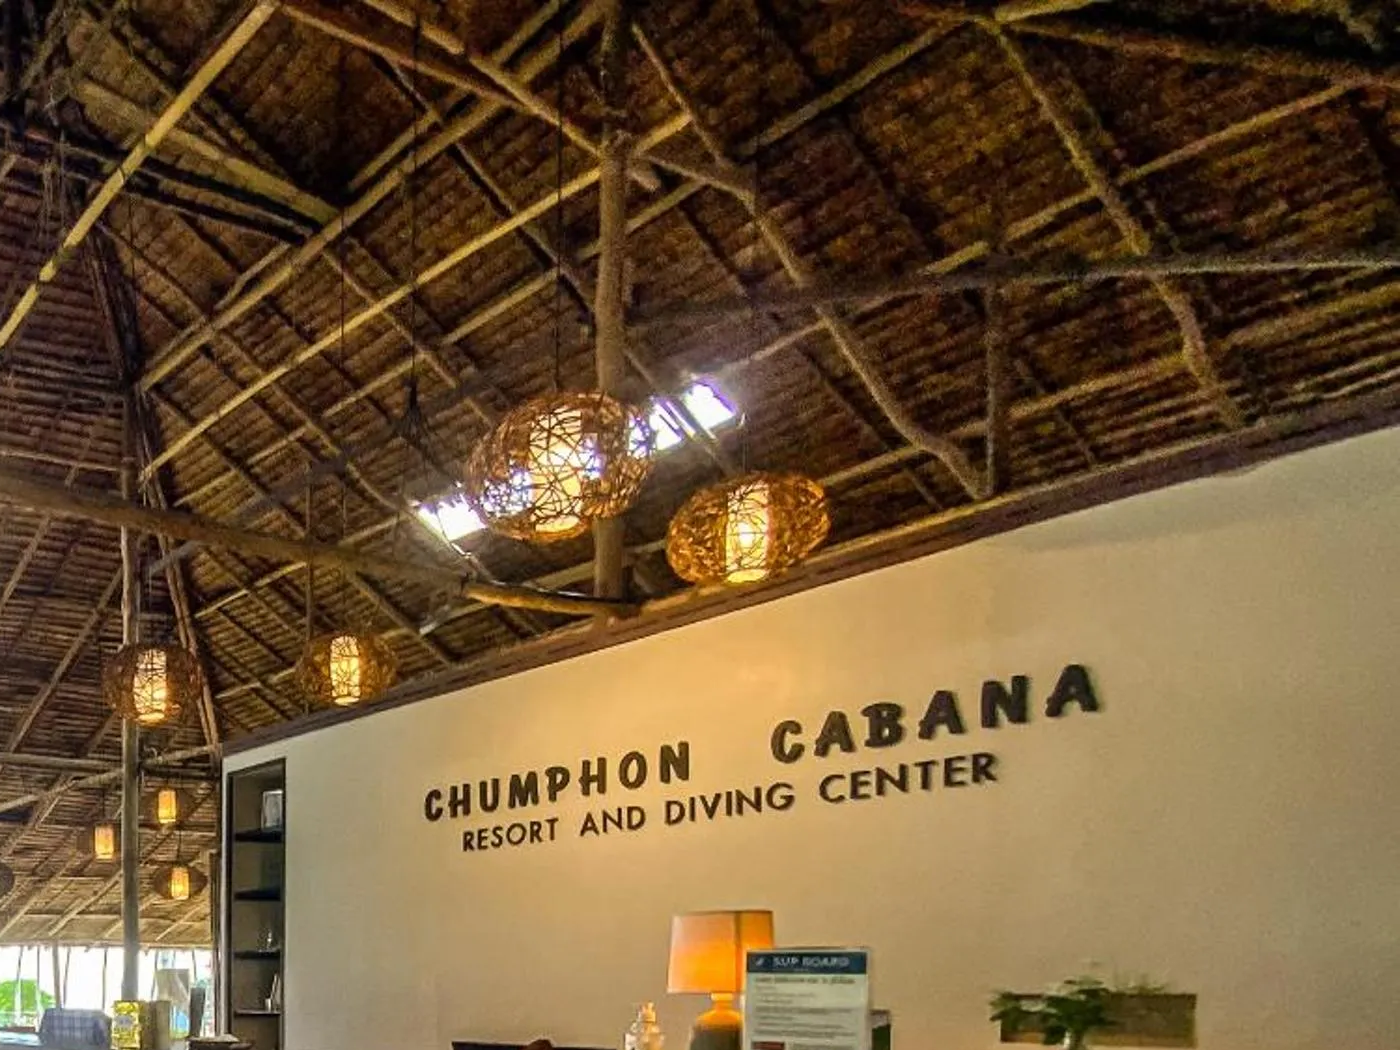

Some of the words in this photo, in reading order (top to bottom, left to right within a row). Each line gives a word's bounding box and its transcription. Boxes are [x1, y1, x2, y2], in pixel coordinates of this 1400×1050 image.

[425, 741, 690, 822] CHUMPHON
[770, 664, 1099, 763] CABANA
[462, 818, 559, 852] RESORT
[579, 806, 646, 837] AND
[664, 783, 796, 825] DIVING
[818, 752, 997, 803] CENTER
[802, 956, 850, 968] BOARD
